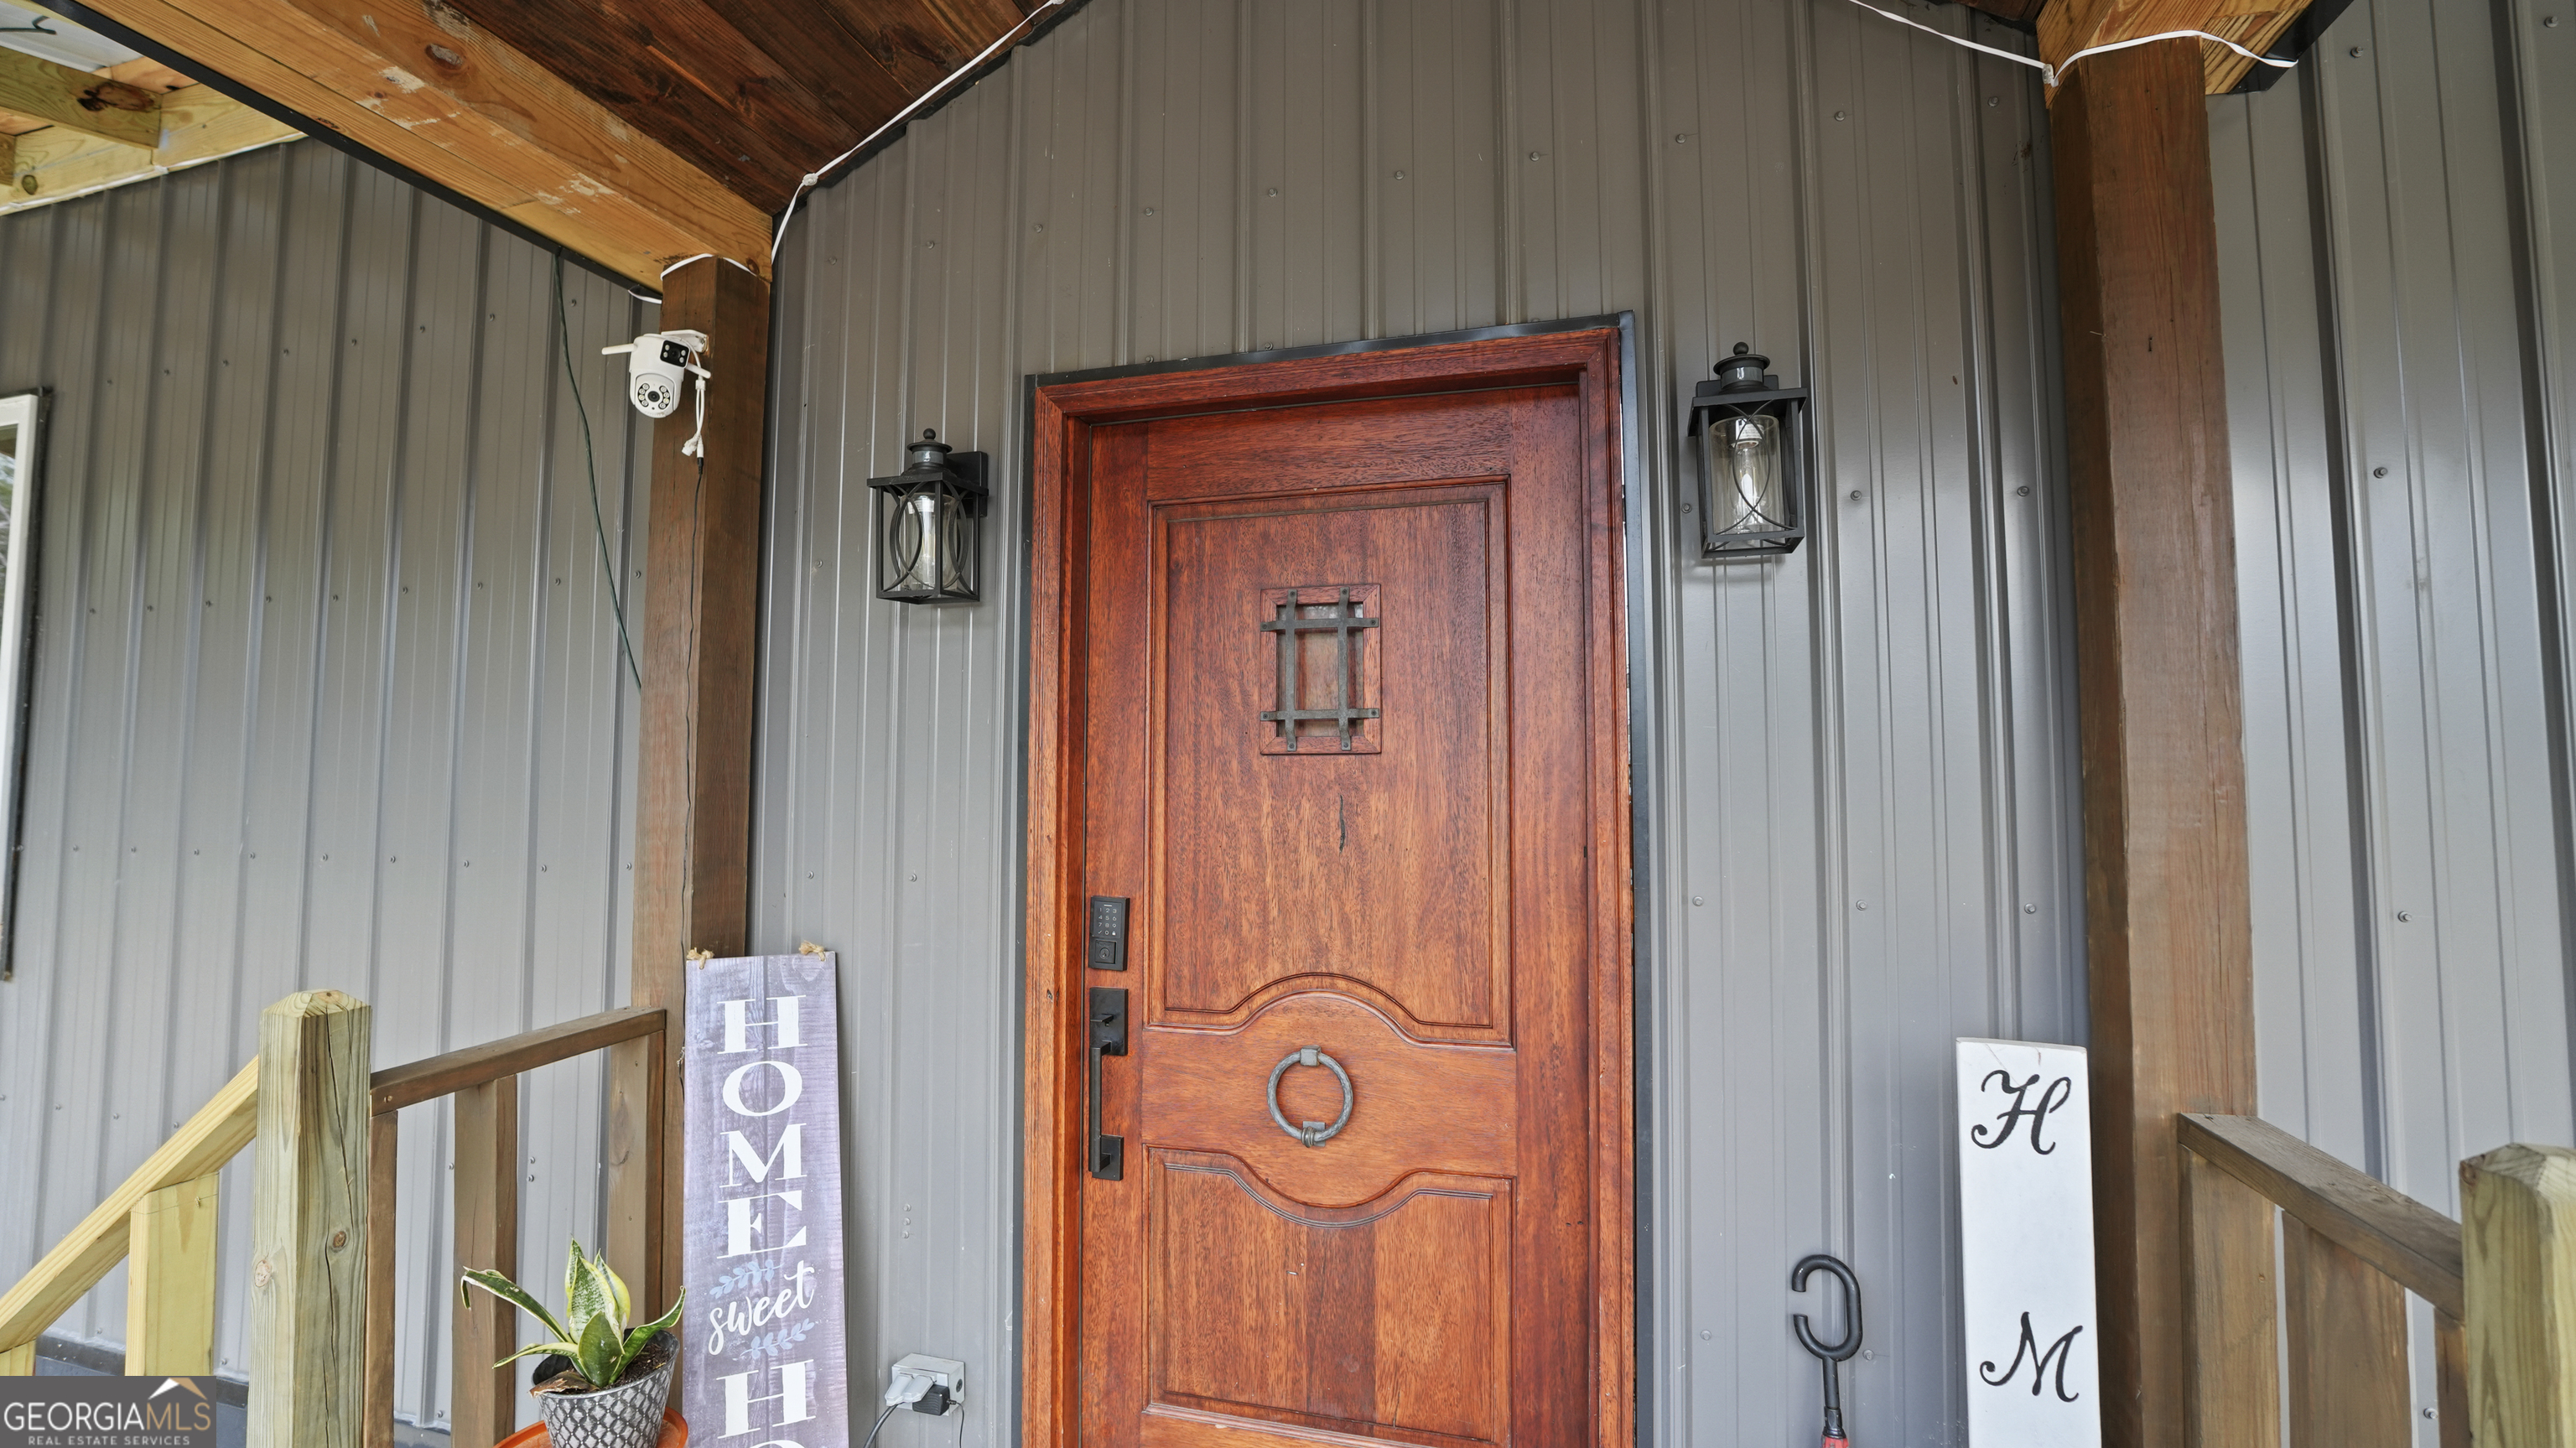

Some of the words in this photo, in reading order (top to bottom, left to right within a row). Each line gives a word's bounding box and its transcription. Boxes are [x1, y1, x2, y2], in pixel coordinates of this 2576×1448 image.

[716, 994, 808, 1259] HOME
[1971, 1069, 2072, 1155] H
[708, 1259, 815, 1356] sweet
[1979, 1311, 2084, 1403] M
[715, 1359, 816, 1448] H
